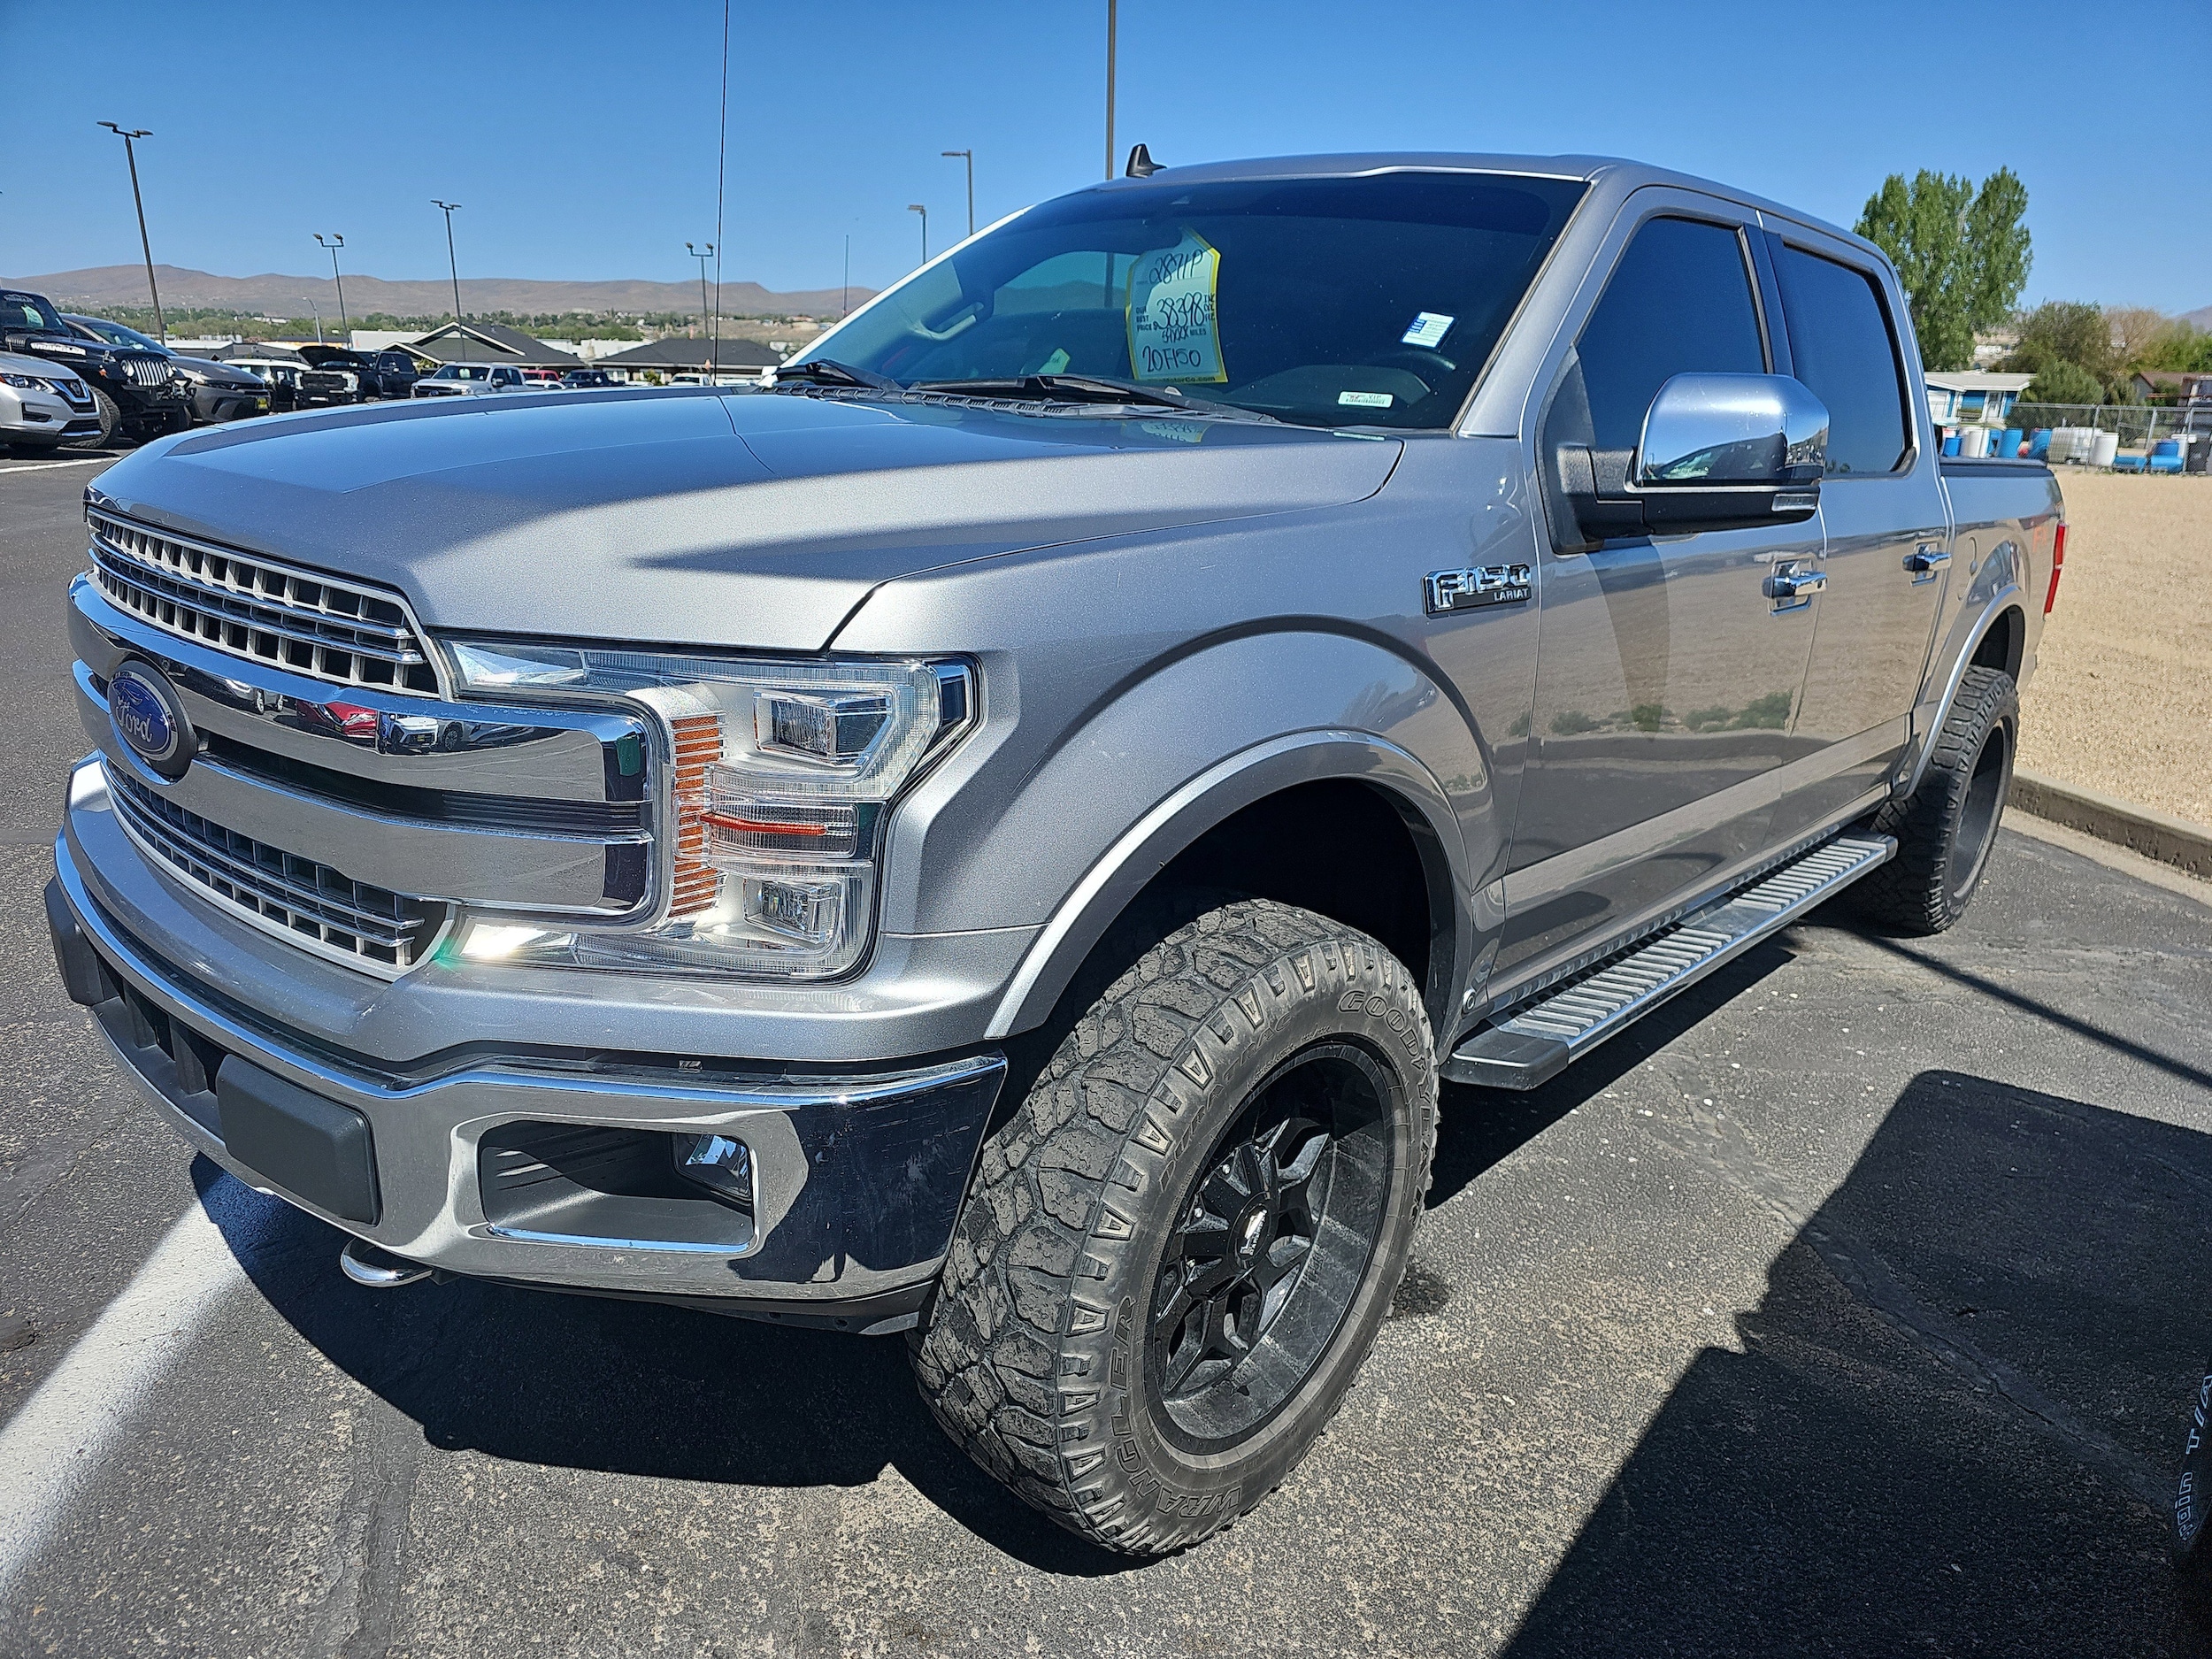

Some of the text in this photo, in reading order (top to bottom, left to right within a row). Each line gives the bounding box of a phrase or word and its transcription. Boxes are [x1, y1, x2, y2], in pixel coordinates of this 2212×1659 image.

[1493, 588, 1529, 602] LARIAT
[115, 694, 153, 743] Ford
[1110, 1295, 1242, 1518] WRANGLER
